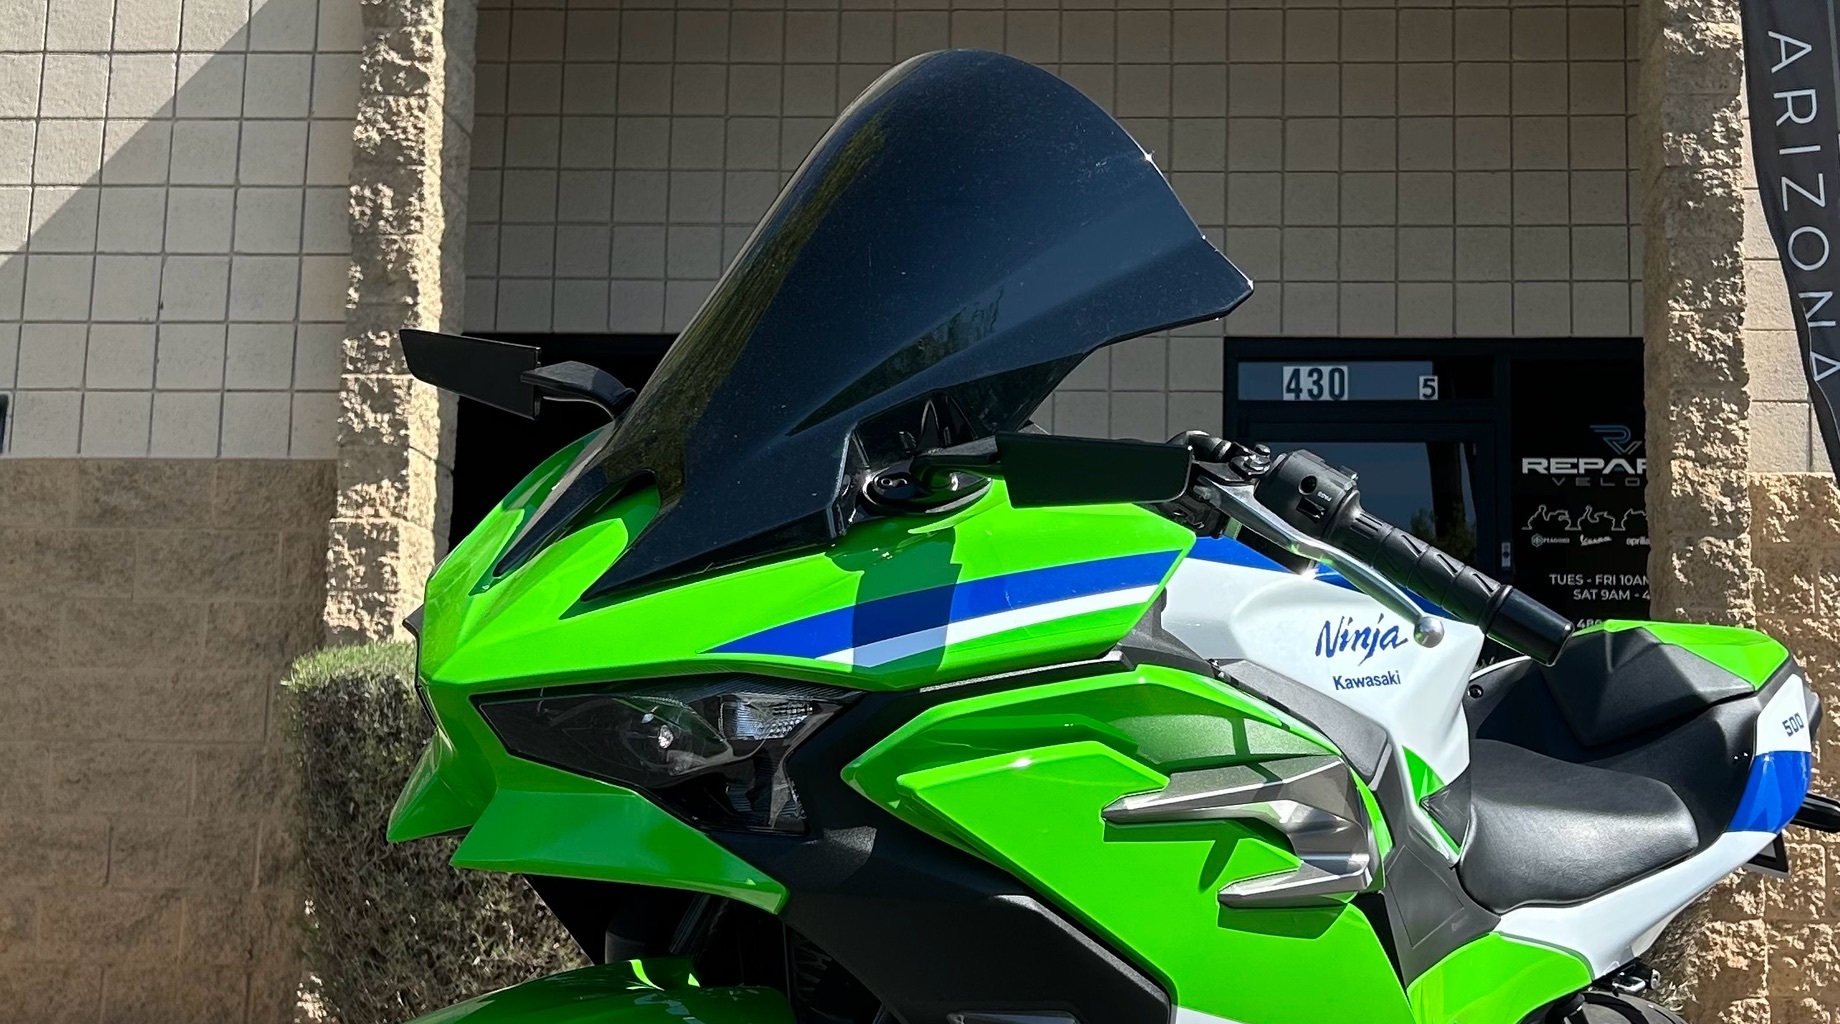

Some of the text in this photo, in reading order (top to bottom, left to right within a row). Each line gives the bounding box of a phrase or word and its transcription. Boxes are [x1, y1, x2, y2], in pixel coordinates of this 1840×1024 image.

[1768, 31, 1840, 382] ARIZONA
[1285, 367, 1346, 400] 430
[1422, 378, 1436, 399] 5
[1549, 574, 1584, 586] TUES
[1595, 574, 1616, 586] FRI
[1573, 589, 1598, 601] SAT
[1600, 589, 1630, 601] 9AM
[1315, 612, 1409, 667] Ninja
[1332, 669, 1401, 691] Kawasaki
[1782, 712, 1805, 737] 500
